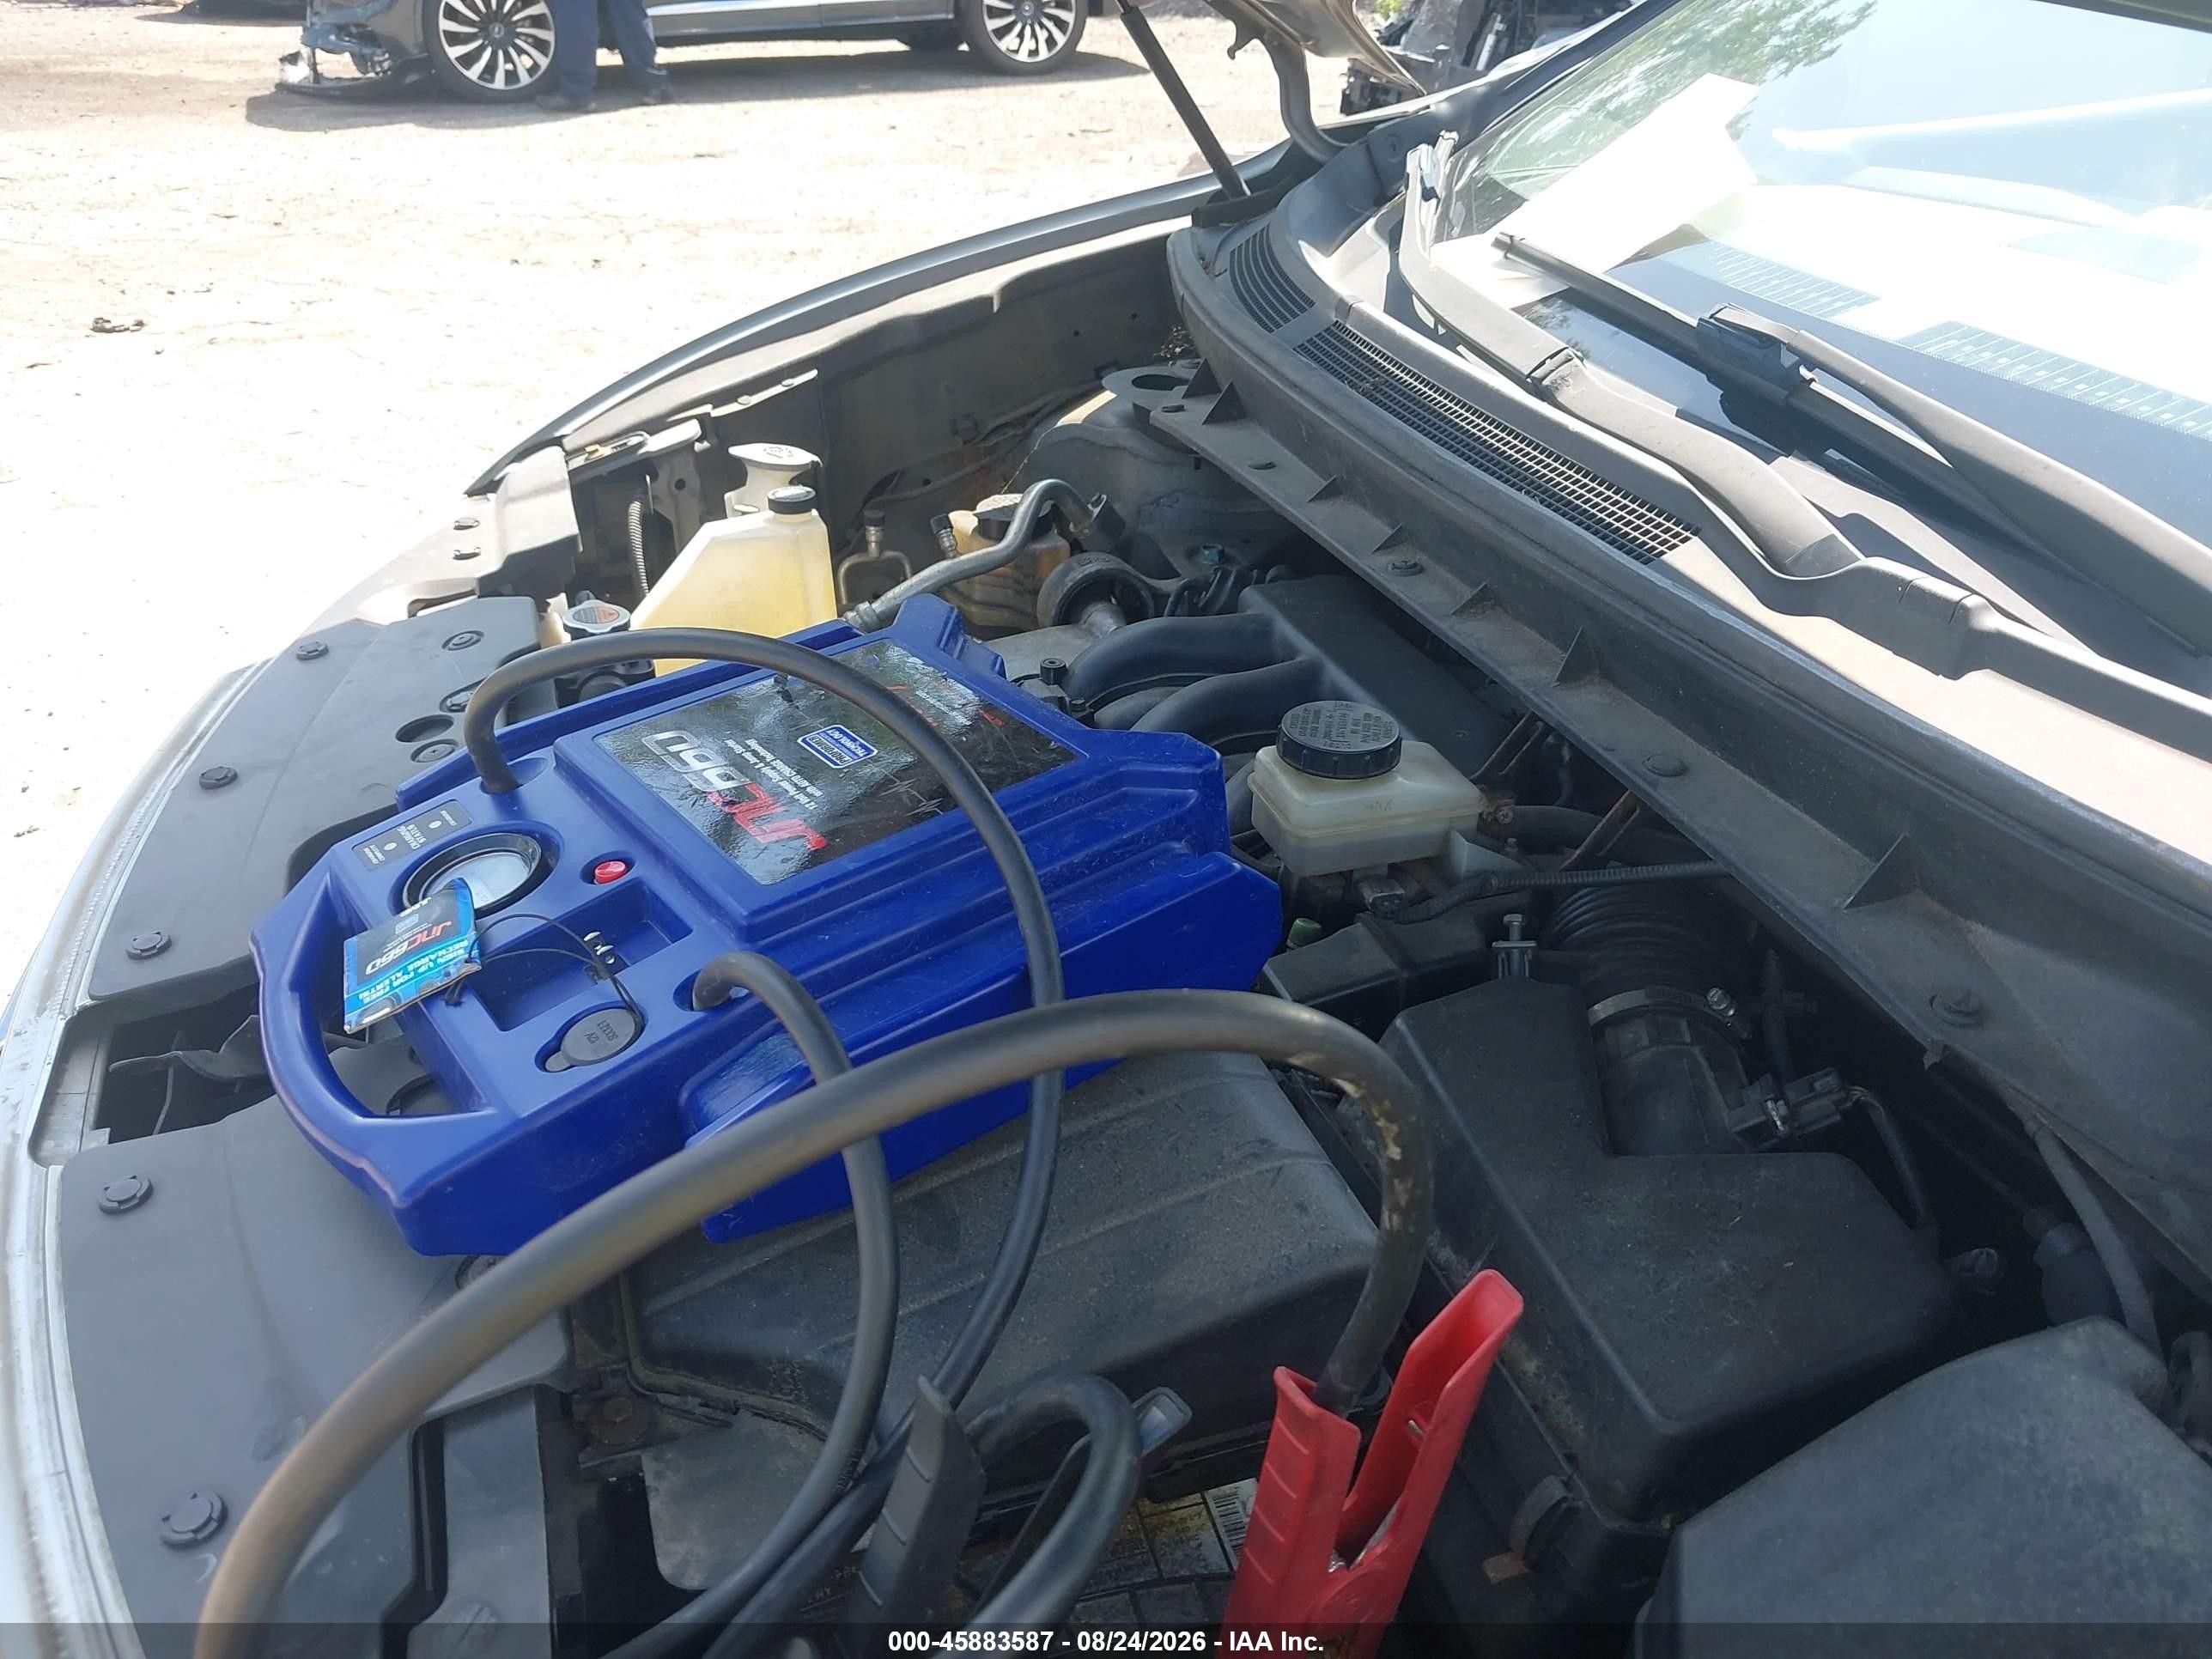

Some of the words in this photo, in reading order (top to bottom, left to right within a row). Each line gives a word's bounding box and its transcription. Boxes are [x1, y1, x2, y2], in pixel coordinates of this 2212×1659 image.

[723, 738, 746, 753] Starter
[743, 738, 778, 761] Technology
[807, 735, 850, 763] PROFORMER
[824, 728, 869, 757] TECHNOLOGY
[739, 750, 762, 764] Jump
[757, 765, 784, 781] Supply
[769, 758, 798, 776] CHARGE
[641, 728, 825, 848] JNC660
[776, 780, 799, 794] Power
[789, 775, 811, 787] AUTO
[793, 793, 811, 804] Volt
[804, 785, 823, 797] with
[397, 824, 419, 849] CHARGING
[406, 823, 426, 843] STATUS
[365, 921, 452, 975] JNC660
[405, 940, 468, 969] RECHARGE
[437, 948, 465, 964] SIGN
[417, 960, 433, 972] UP
[392, 971, 414, 986] FOR
[362, 986, 389, 1003] FREE
